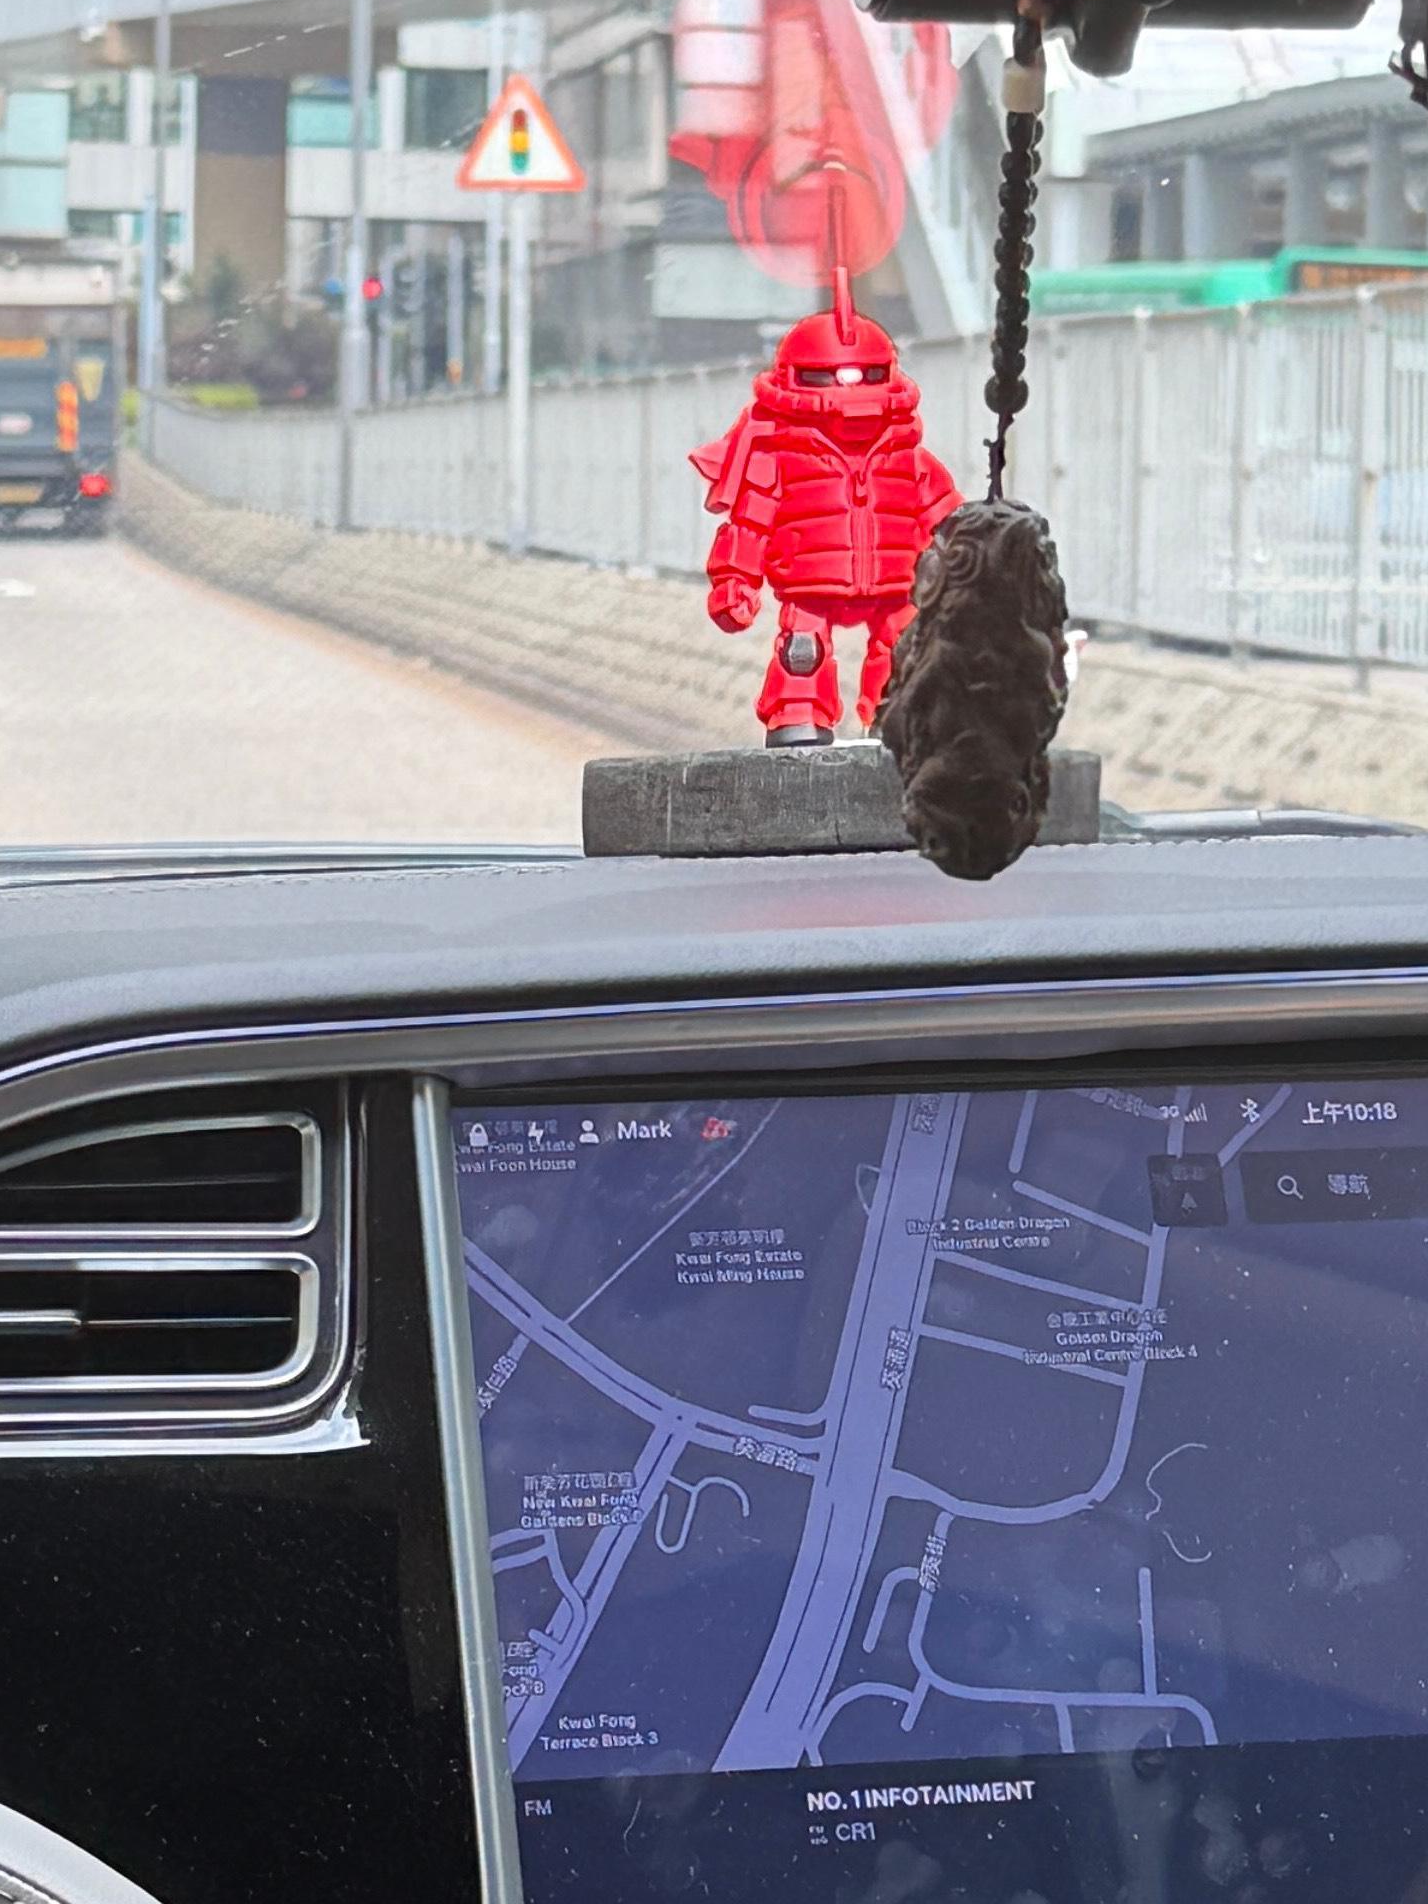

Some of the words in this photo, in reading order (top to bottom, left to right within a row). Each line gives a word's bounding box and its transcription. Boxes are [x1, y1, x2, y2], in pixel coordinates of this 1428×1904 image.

[1301, 1101, 1398, 1126] 上午10:18
[617, 1120, 672, 1141] Mark
[530, 1157, 577, 1171] House
[558, 1716, 596, 1730] Kwai
[599, 1715, 637, 1729] Fong
[601, 1733, 645, 1747] Block
[647, 1731, 659, 1745] 3
[865, 1780, 1036, 1809] INFOTAINMENT
[524, 1799, 553, 1817] FM
[835, 1822, 876, 1841] CR1
